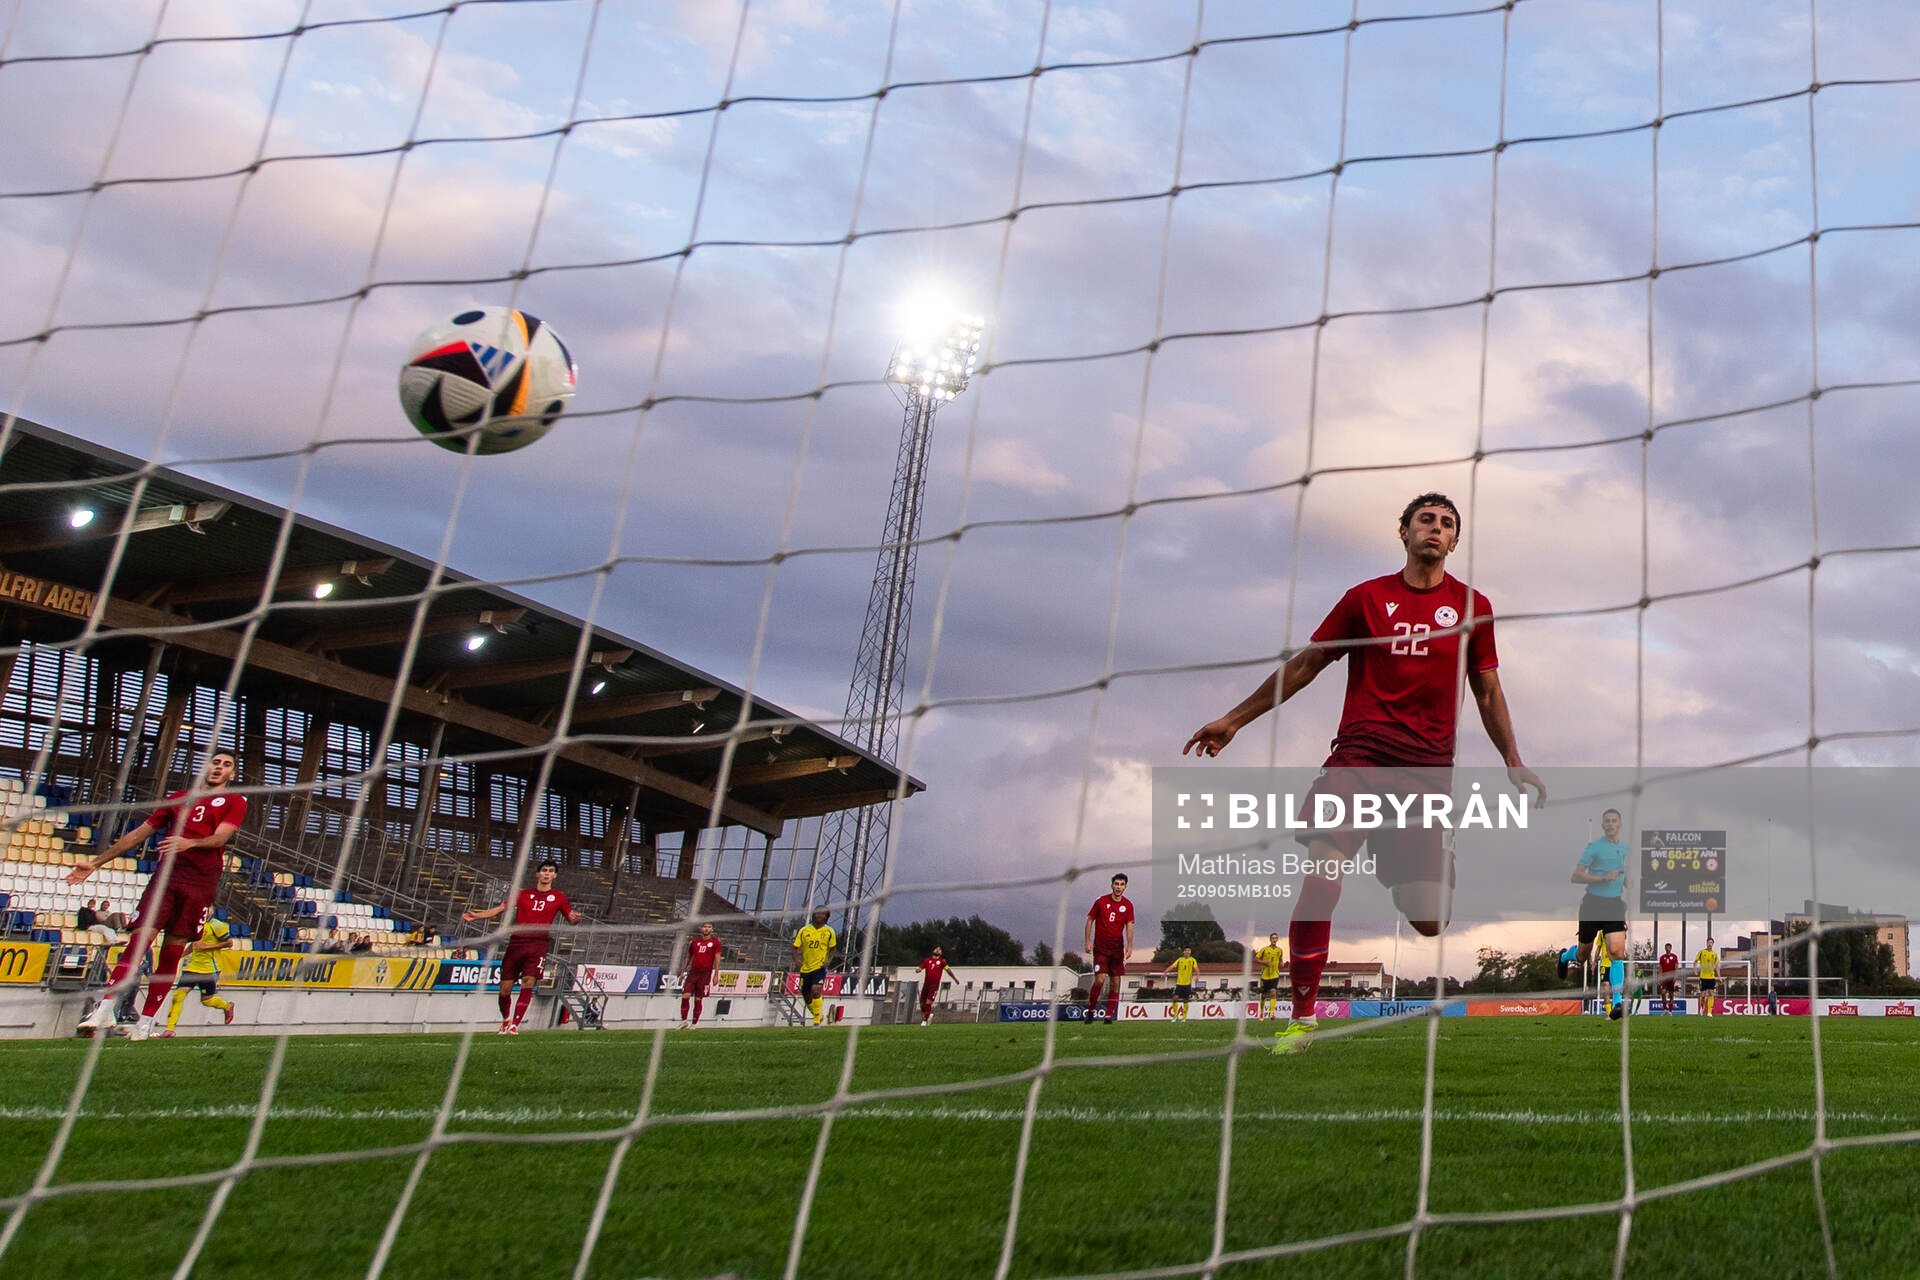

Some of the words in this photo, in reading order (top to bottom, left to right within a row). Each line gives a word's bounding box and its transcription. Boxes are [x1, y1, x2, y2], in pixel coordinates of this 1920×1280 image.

[0, 572, 43, 603] LFRI
[43, 584, 104, 619] AREN
[1391, 622, 1431, 656] 22
[192, 805, 206, 822] 3
[1666, 833, 1702, 841] FALCON
[1668, 850, 1699, 859] 60:27
[531, 900, 546, 911] 13
[1109, 912, 1116, 922] 6
[808, 940, 820, 949] 20
[1125, 1005, 1149, 1018] ICA
[1202, 1004, 1225, 1017] ICA
[1379, 1002, 1440, 1017] Folksa
[1500, 1004, 1537, 1013] Swedbank
